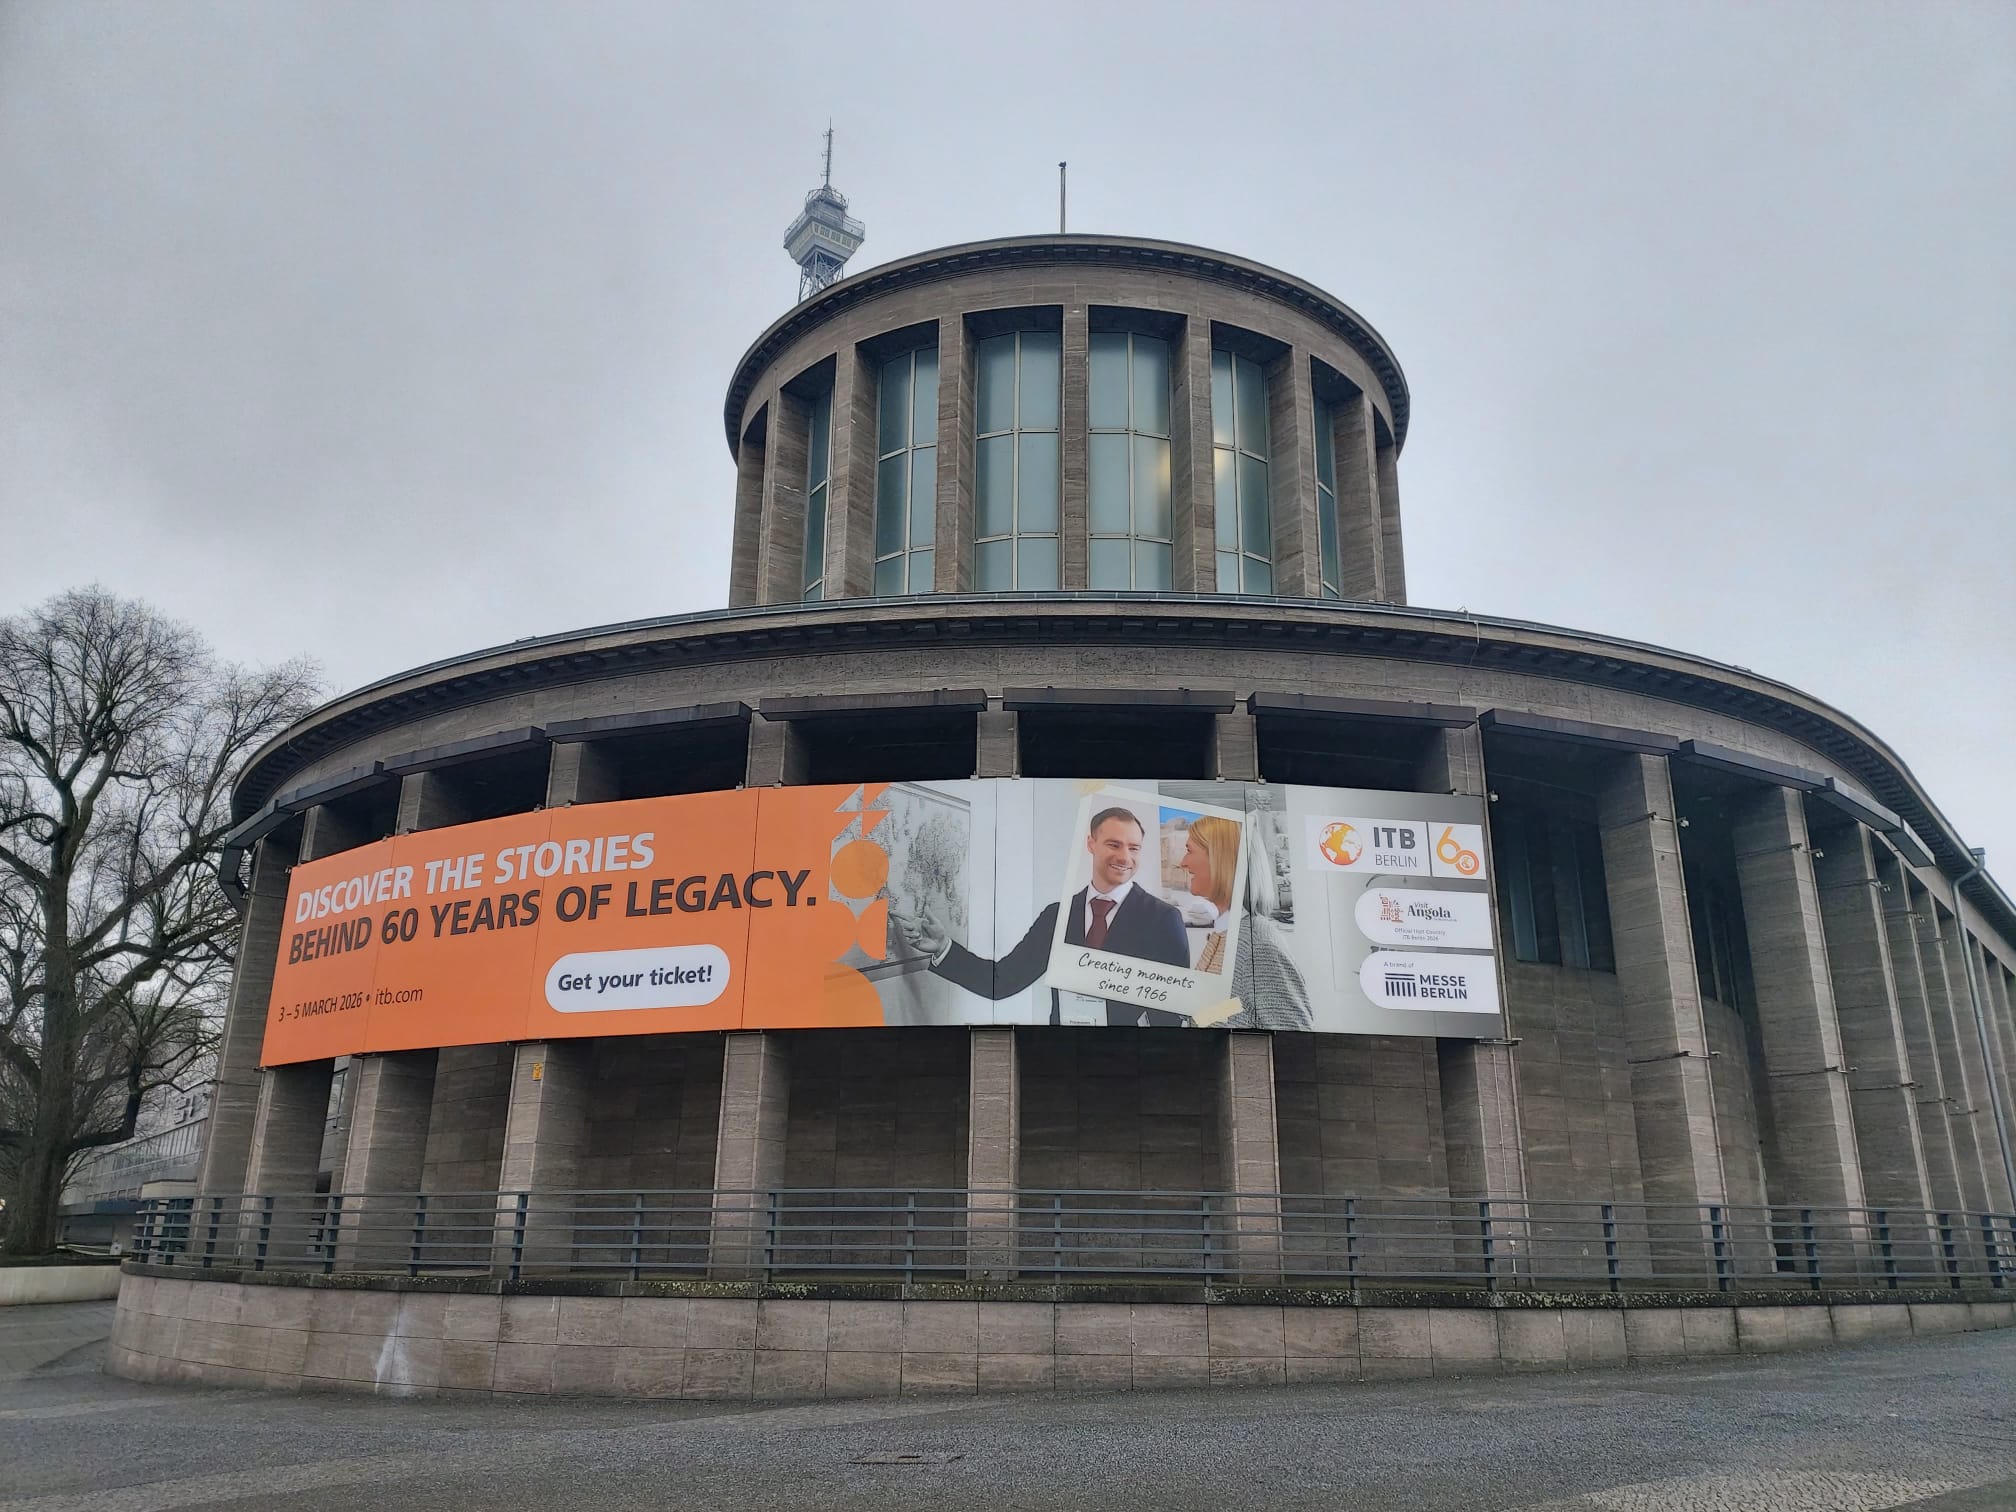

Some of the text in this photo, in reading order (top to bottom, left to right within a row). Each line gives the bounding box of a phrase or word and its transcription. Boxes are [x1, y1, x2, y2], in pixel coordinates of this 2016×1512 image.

[1373, 827, 1416, 850] ITB
[1375, 854, 1418, 868] BERLIN
[295, 832, 655, 924] DISCOVER THE STORIES
[288, 869, 817, 965] BEHIND 60 YEARS OF LEGACY.
[1407, 904, 1451, 921] Angola
[557, 965, 713, 993] Get your ticket!
[1078, 952, 1196, 989] Creating moments
[1420, 974, 1466, 987] MESSE
[1098, 978, 1168, 1002] since 1966
[1421, 987, 1468, 1000] BERLIN
[278, 1006, 285, 1022] 3
[294, 1003, 301, 1020] 5
[302, 997, 338, 1018] MARCH
[339, 991, 363, 1011] 2026
[375, 988, 423, 1006] itb.com
